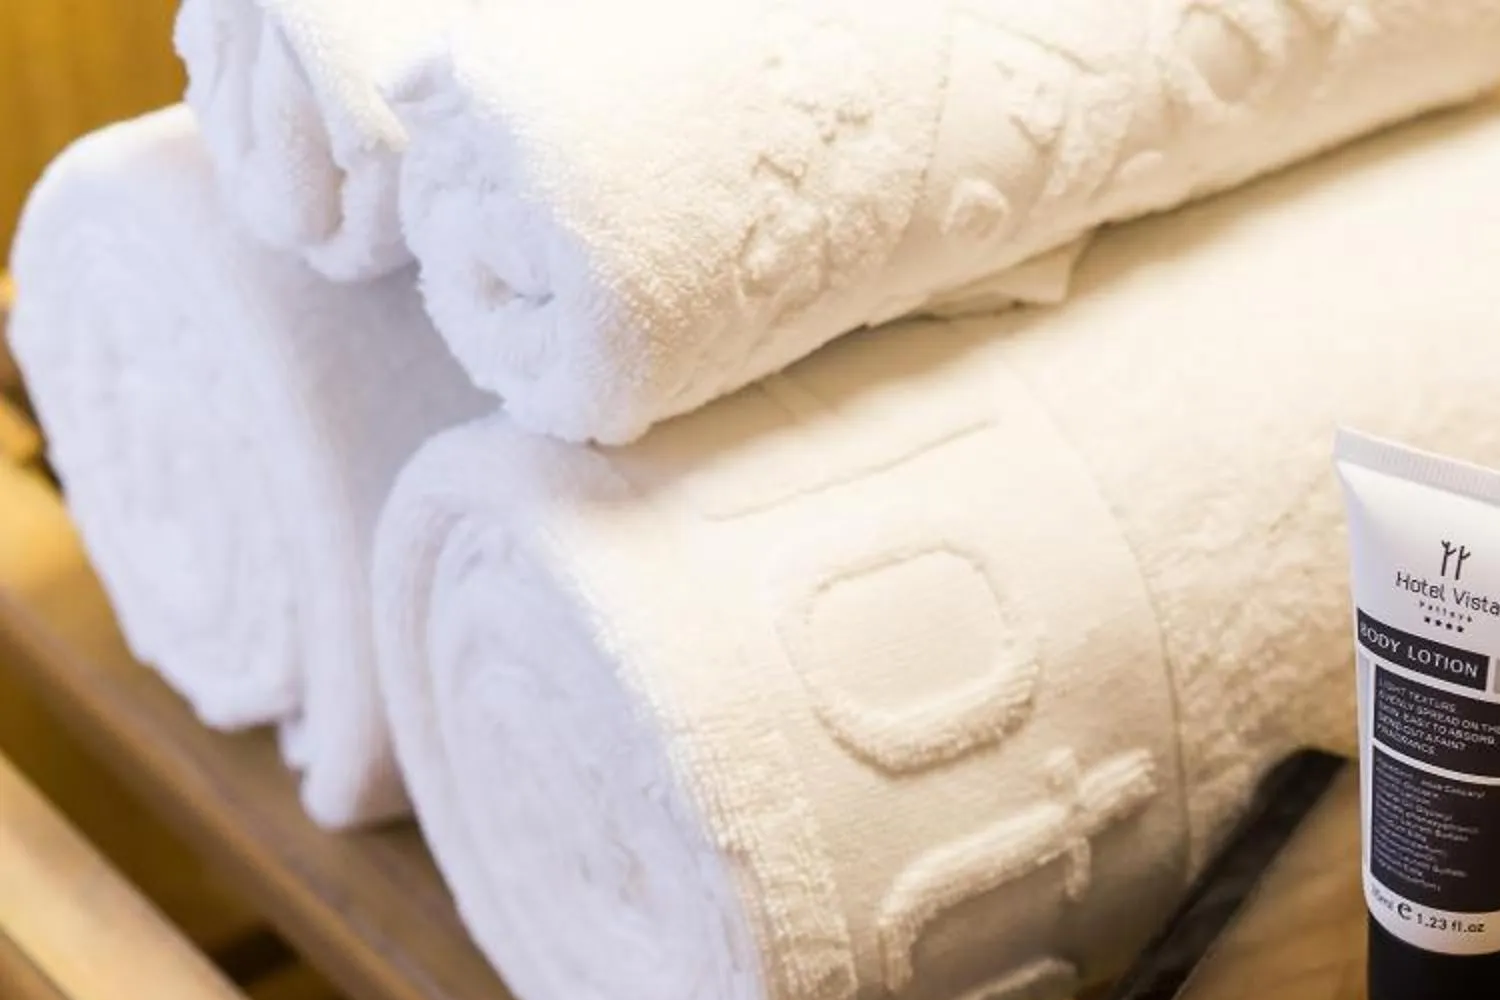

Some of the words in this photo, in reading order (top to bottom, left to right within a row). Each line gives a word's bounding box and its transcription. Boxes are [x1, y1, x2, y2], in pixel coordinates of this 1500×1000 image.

[1395, 571, 1446, 601] Hotel
[1453, 588, 1500, 616] Vista
[1359, 621, 1400, 653] BODY
[1408, 645, 1479, 679] LOTION
[1417, 705, 1460, 726] SPREAD
[1462, 719, 1479, 730] ON
[1433, 722, 1446, 735] TO
[1417, 913, 1448, 931] 1.23
[1451, 919, 1486, 933] fl.oz
